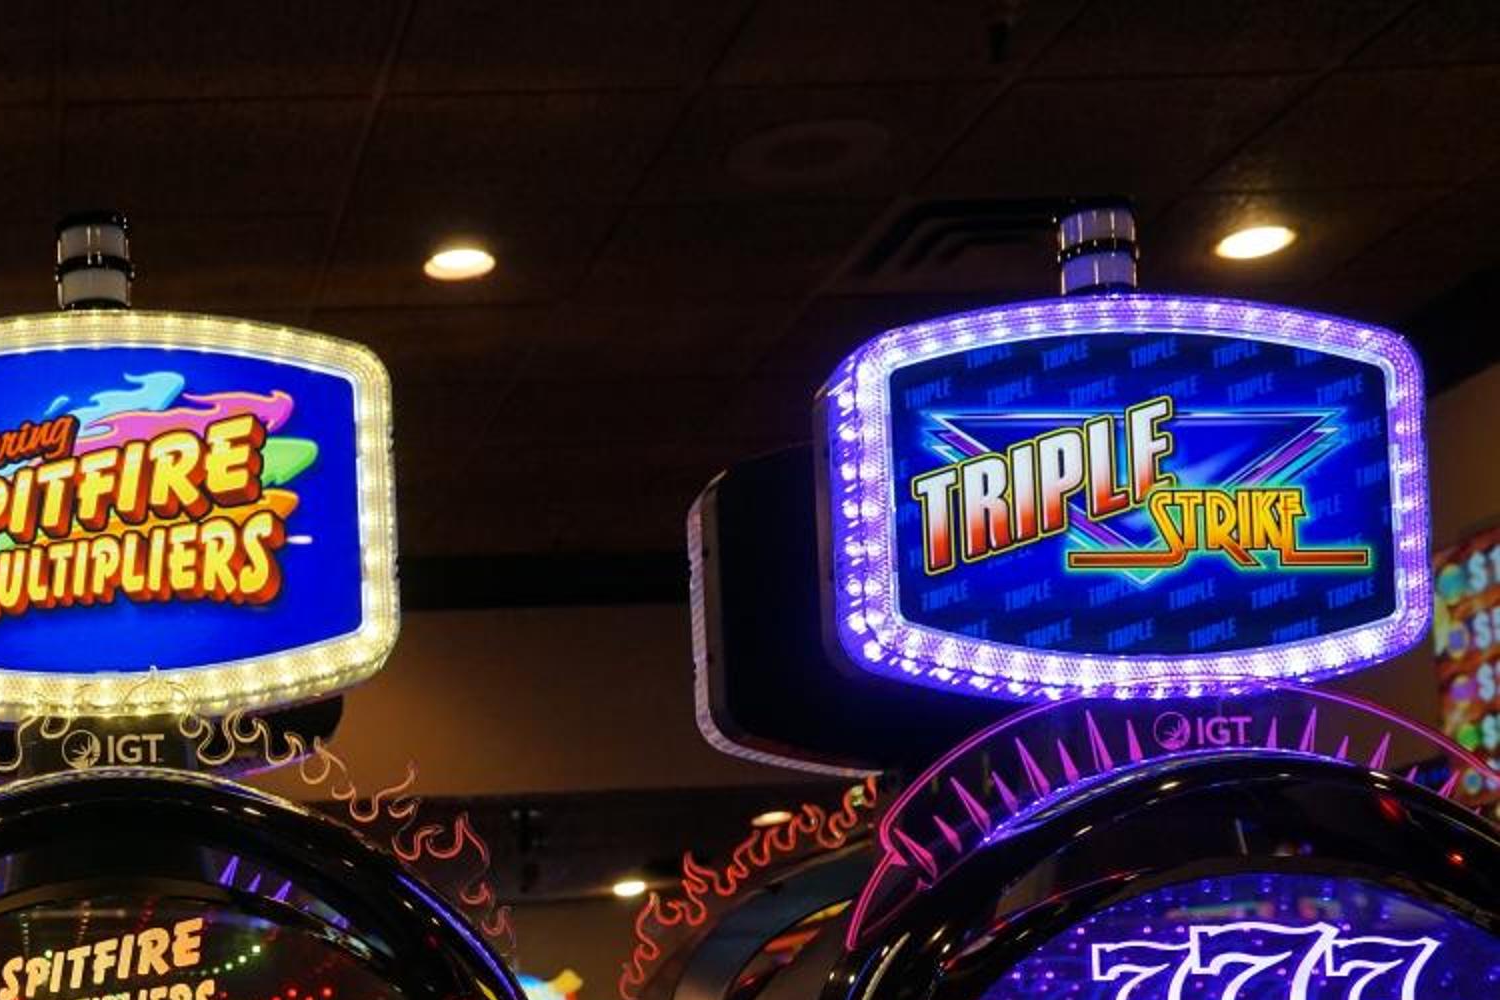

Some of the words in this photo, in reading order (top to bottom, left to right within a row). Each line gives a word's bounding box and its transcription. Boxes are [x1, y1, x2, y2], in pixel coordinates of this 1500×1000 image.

[912, 396, 1176, 576] TRIPLE
[1197, 716, 1252, 744] IGT
[108, 733, 164, 763] IGT
